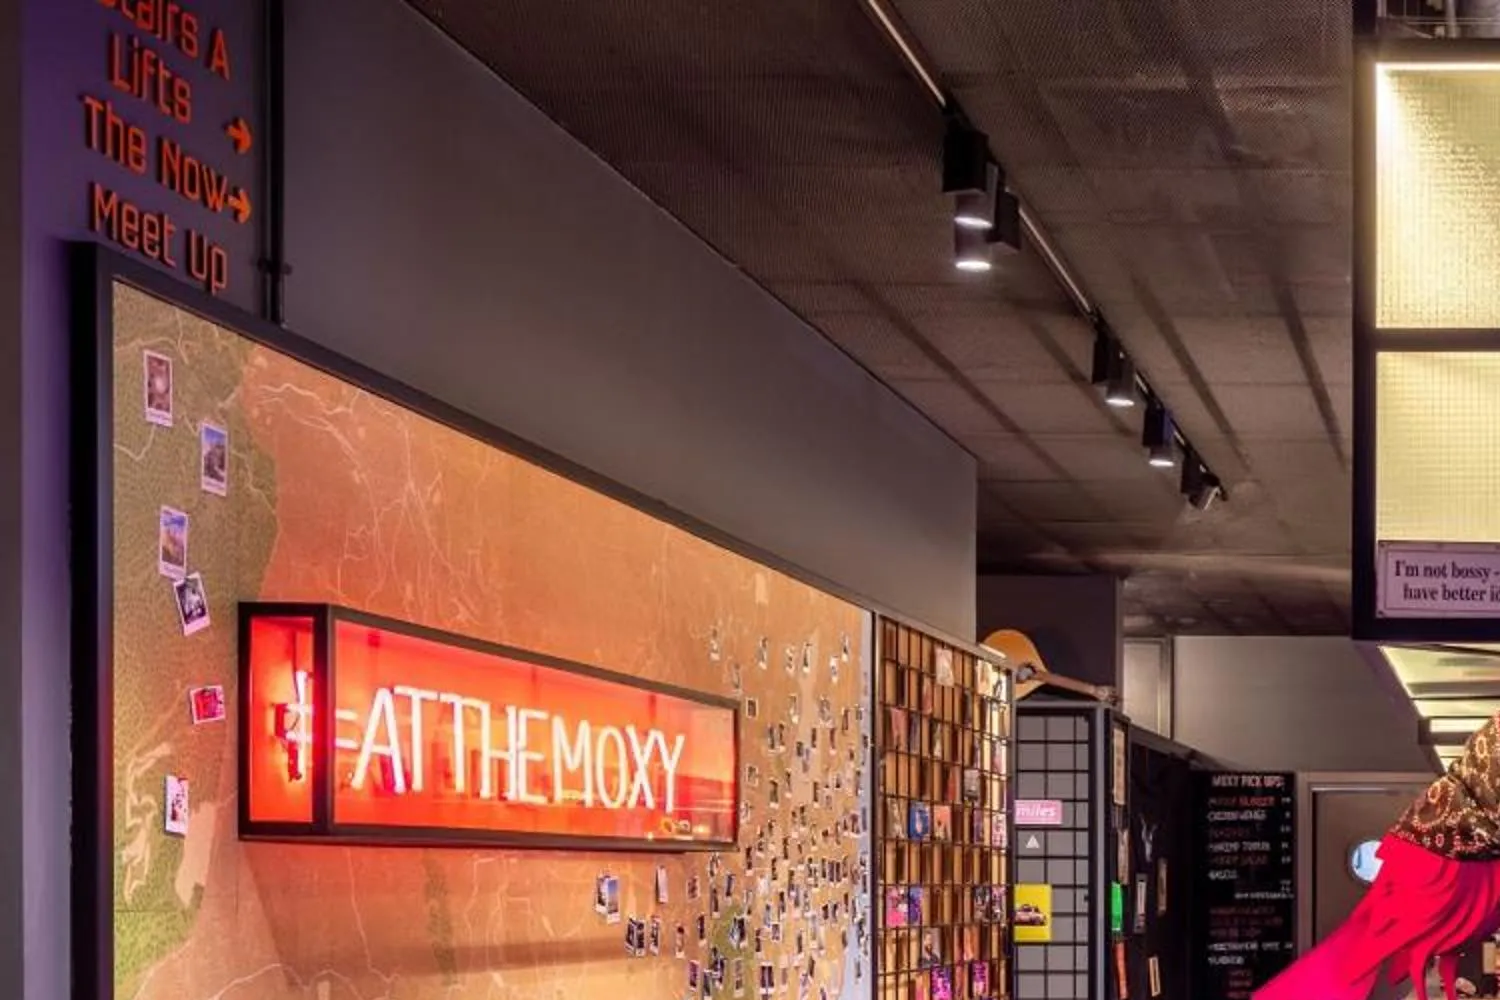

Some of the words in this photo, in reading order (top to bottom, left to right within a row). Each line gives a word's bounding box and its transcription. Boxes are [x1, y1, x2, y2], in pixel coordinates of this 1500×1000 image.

[98, 0, 198, 58] airs
[210, 28, 230, 81] A
[113, 32, 191, 123] Lifts
[84, 96, 147, 175] The
[93, 183, 177, 268] Meet
[190, 229, 228, 296] Up
[1394, 560, 1419, 577] I'm
[1423, 562, 1448, 579] not
[1451, 561, 1490, 583] bossy
[1403, 583, 1438, 600] have
[1441, 584, 1487, 602] better
